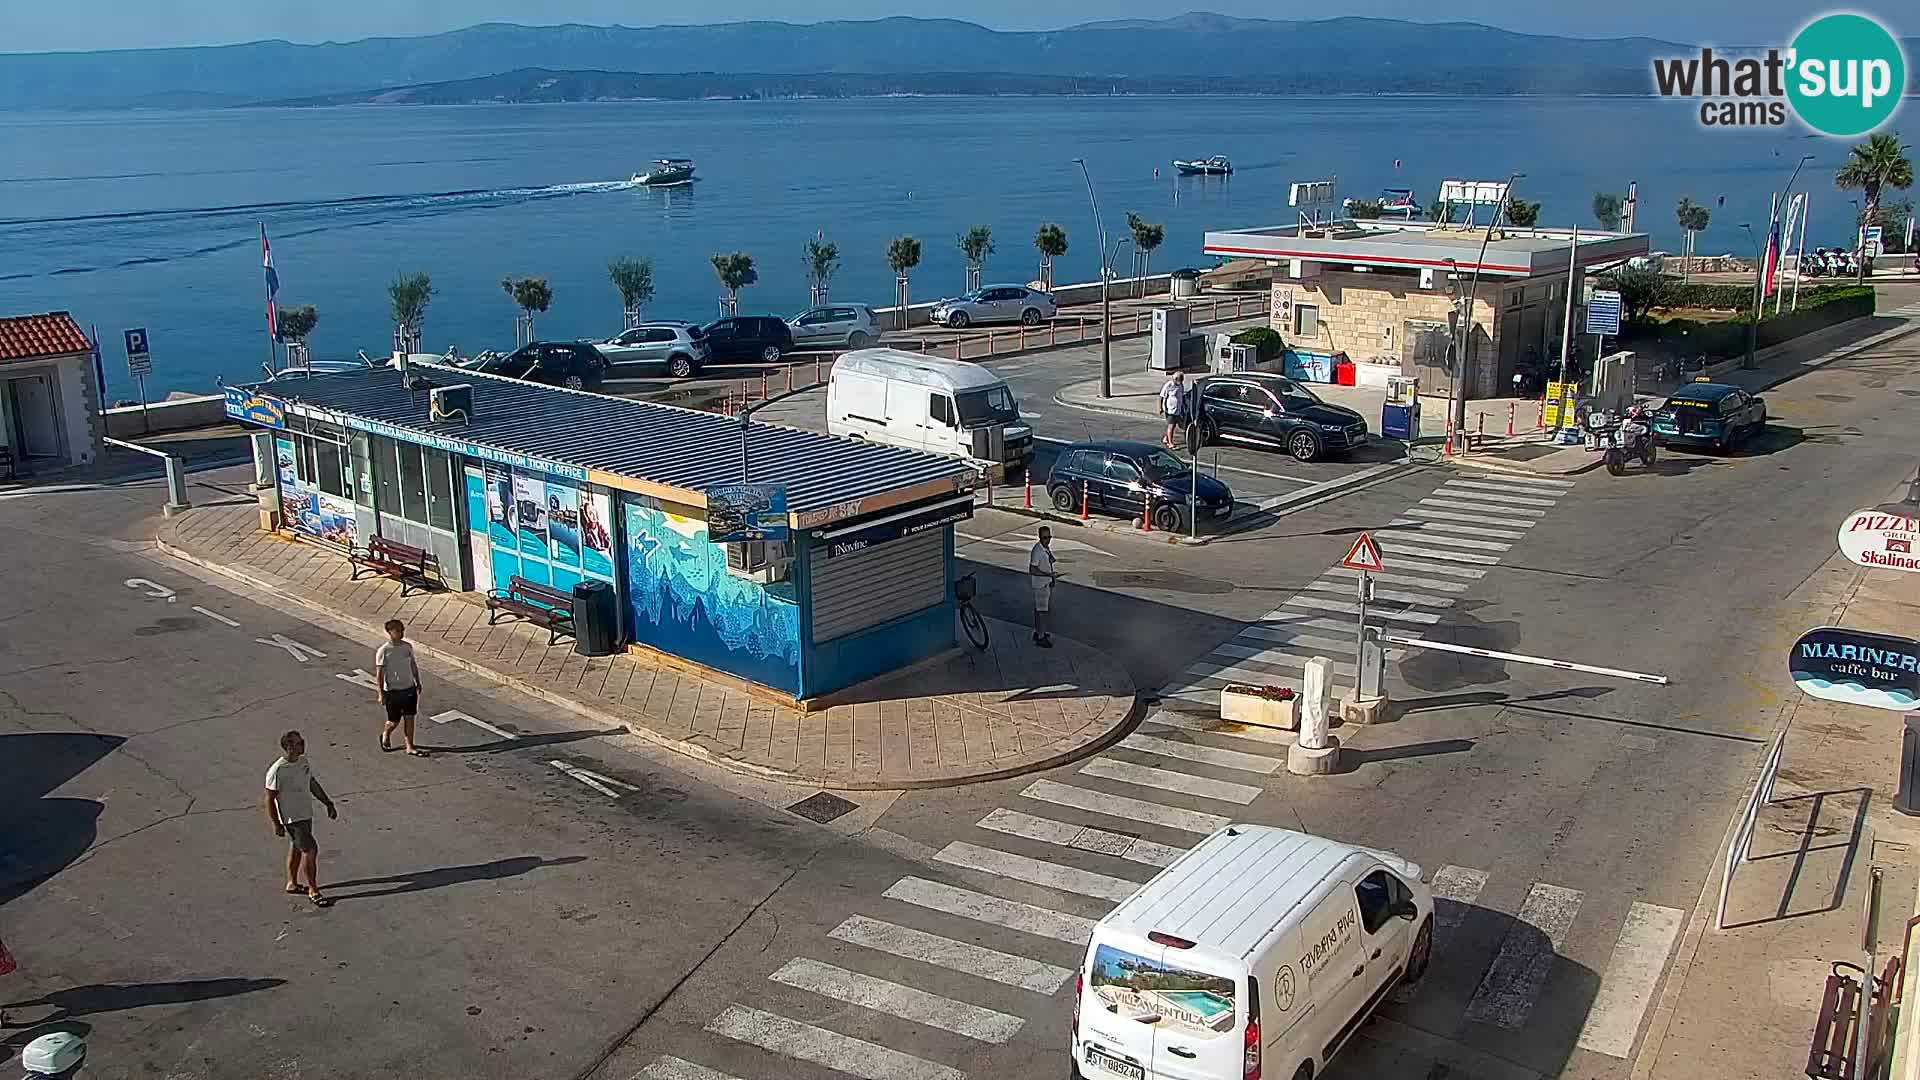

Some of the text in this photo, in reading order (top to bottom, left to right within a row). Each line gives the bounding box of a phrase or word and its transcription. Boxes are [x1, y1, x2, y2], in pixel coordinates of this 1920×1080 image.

[130, 332, 142, 350] P
[436, 438, 467, 453] POSTAJA
[478, 447, 492, 459] BUS
[494, 450, 526, 466] STATION
[528, 459, 554, 472] TICKET
[556, 463, 582, 478] OFFICE
[1849, 515, 1920, 533] PIZZE
[1830, 663, 1899, 680] caffe bar
[1114, 991, 1206, 1026] VILLA VENTULA
[1092, 1053, 1103, 1065] ST
